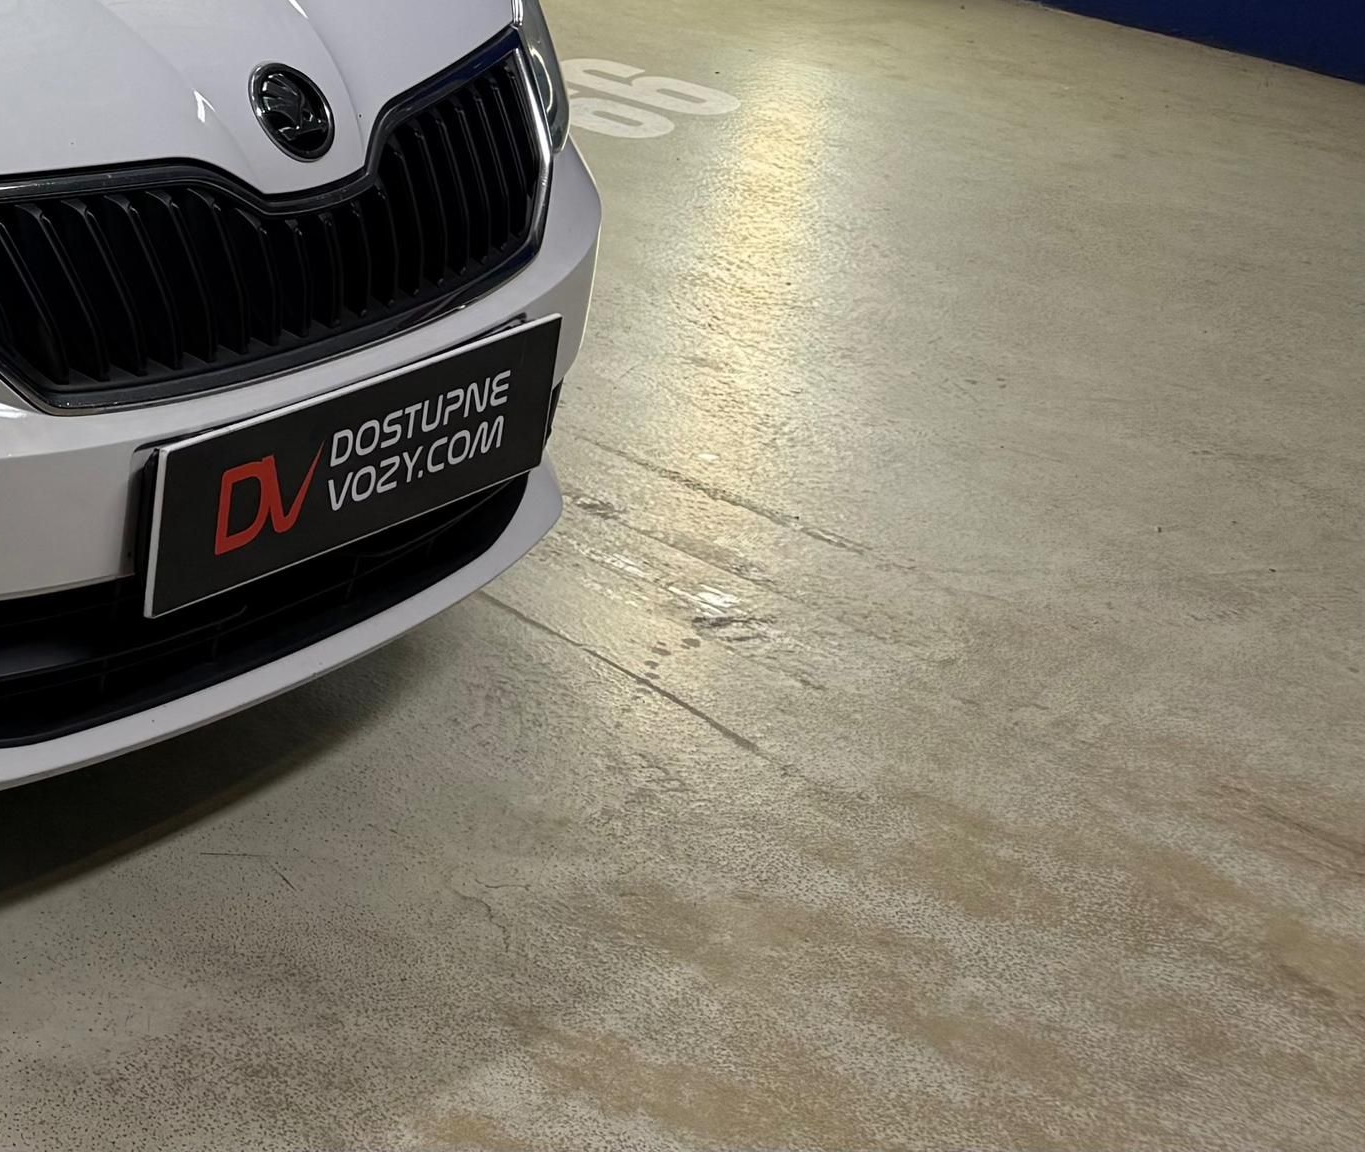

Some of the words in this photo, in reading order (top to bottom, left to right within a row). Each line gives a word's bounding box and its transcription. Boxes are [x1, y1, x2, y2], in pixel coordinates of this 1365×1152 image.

[327, 415, 504, 511] VOZY.COM
[328, 370, 512, 467] DOSTUPNE
[214, 440, 326, 556] DV
